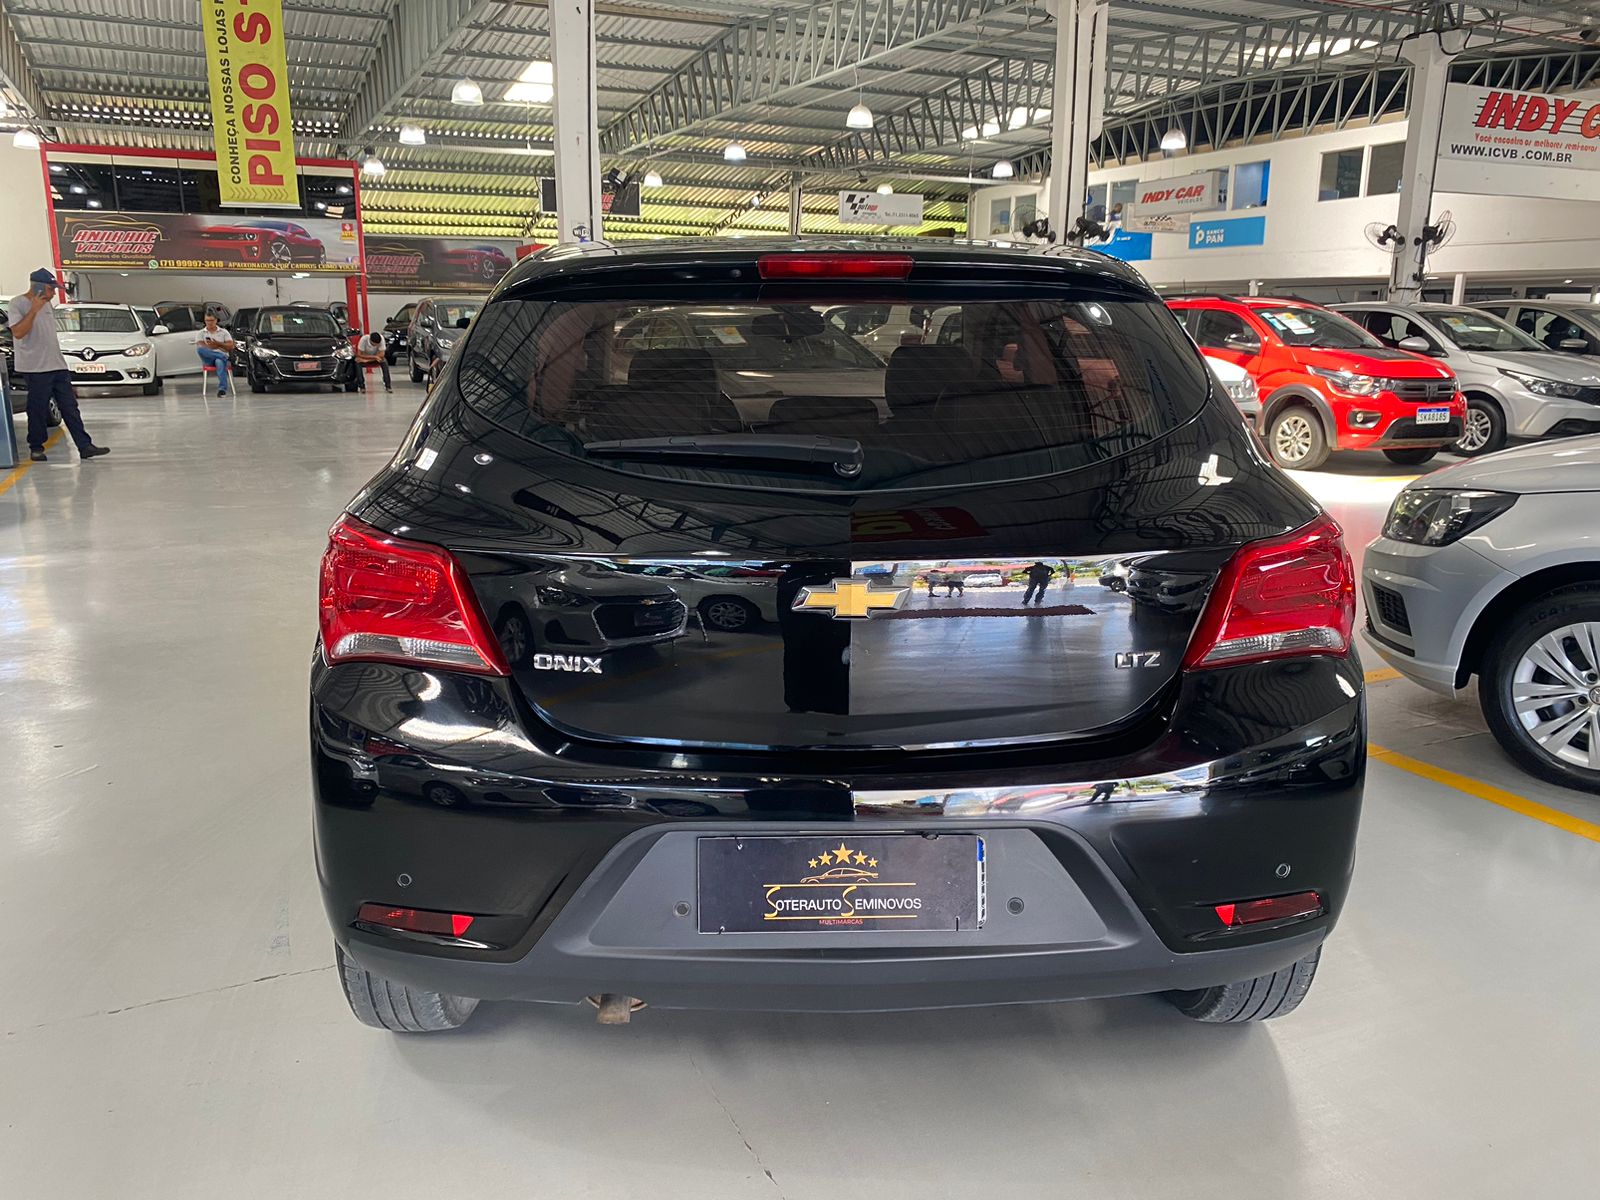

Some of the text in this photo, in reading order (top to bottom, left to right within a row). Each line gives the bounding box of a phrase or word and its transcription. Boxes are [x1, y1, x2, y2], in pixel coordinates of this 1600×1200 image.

[215, 8, 228, 54] LOJAS
[220, 58, 234, 114] NOSSAS
[239, 63, 284, 186] PISO
[1475, 91, 1582, 134] INDY
[226, 119, 241, 184] CONHEÇA
[1141, 188, 1176, 205] INDY
[1176, 184, 1205, 200] CAR
[1206, 234, 1224, 244] PAN
[533, 653, 603, 674] ONIX
[1114, 651, 1161, 669] LTZ
[818, 918, 863, 926] MULTIMARCAS
